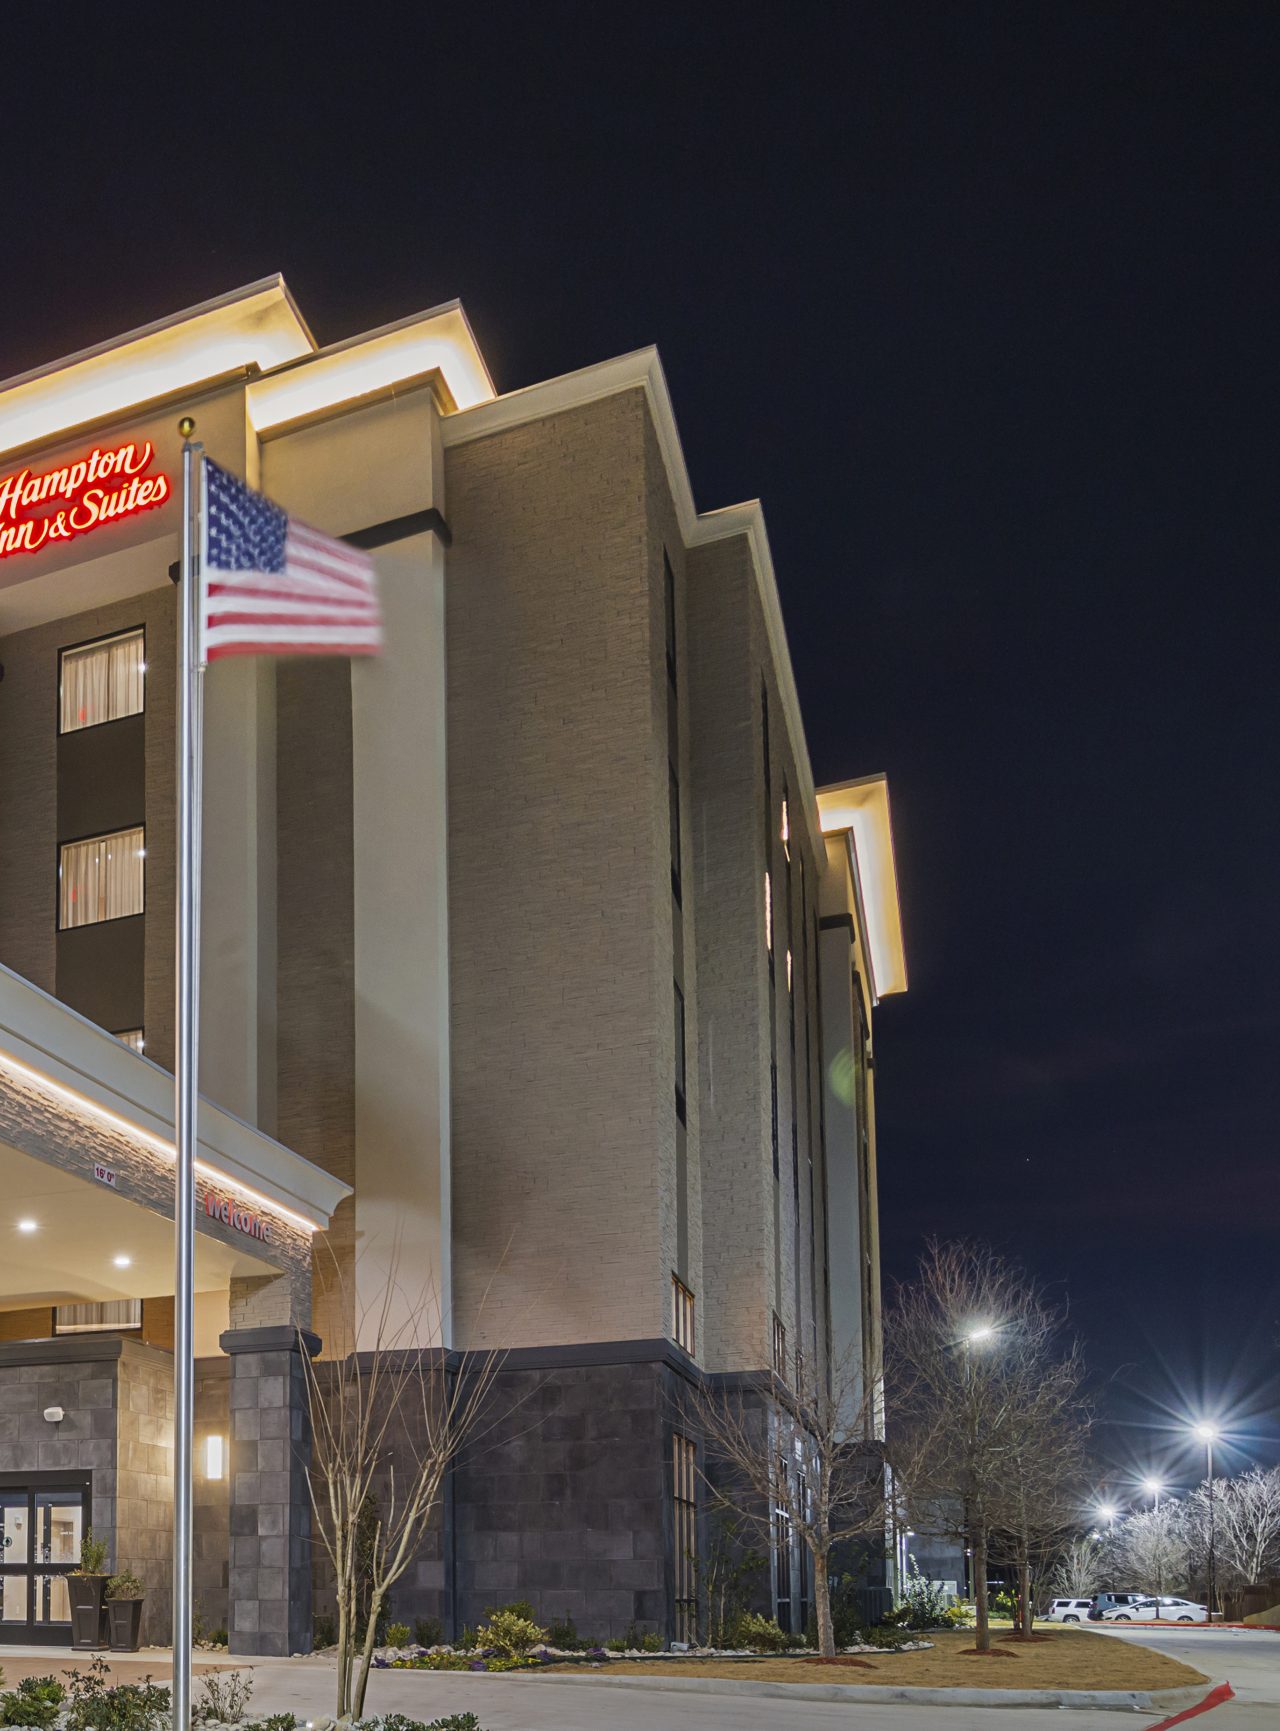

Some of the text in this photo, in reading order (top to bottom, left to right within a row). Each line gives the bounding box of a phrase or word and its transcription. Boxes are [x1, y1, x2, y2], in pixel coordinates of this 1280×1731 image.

[47, 510, 72, 539] &
[69, 474, 168, 530] Suites
[204, 1191, 280, 1246] Welcome
